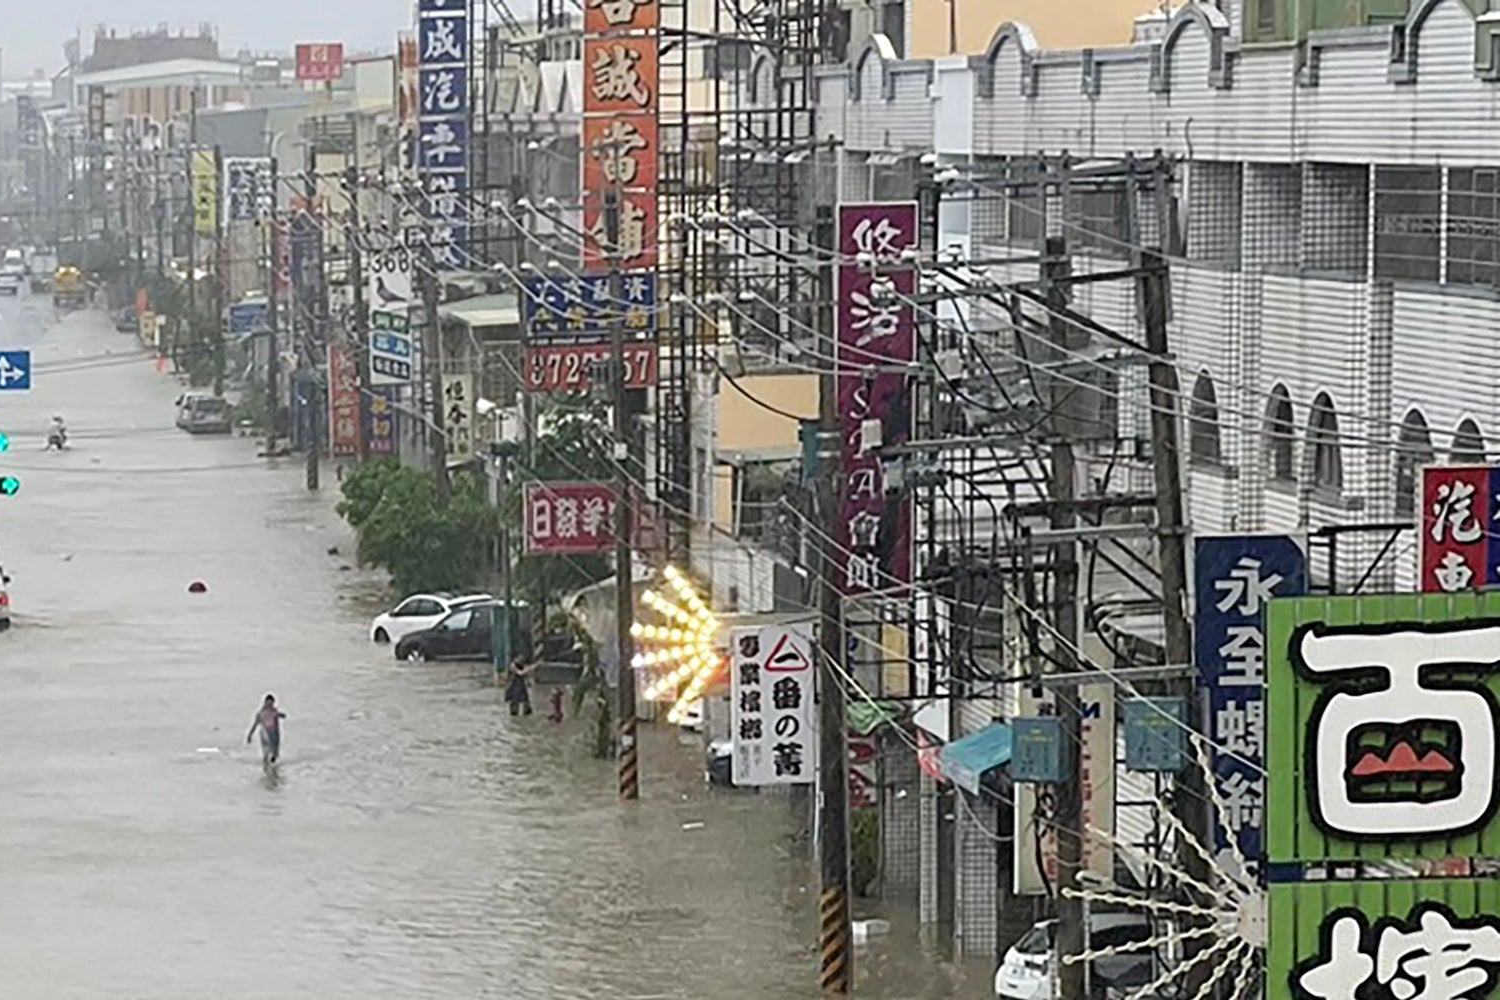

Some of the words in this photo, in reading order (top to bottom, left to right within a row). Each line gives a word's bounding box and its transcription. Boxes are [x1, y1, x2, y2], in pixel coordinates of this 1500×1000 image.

[419, 0, 463, 266] 成汽車借款
[1300, 624, 1500, 834] 百
